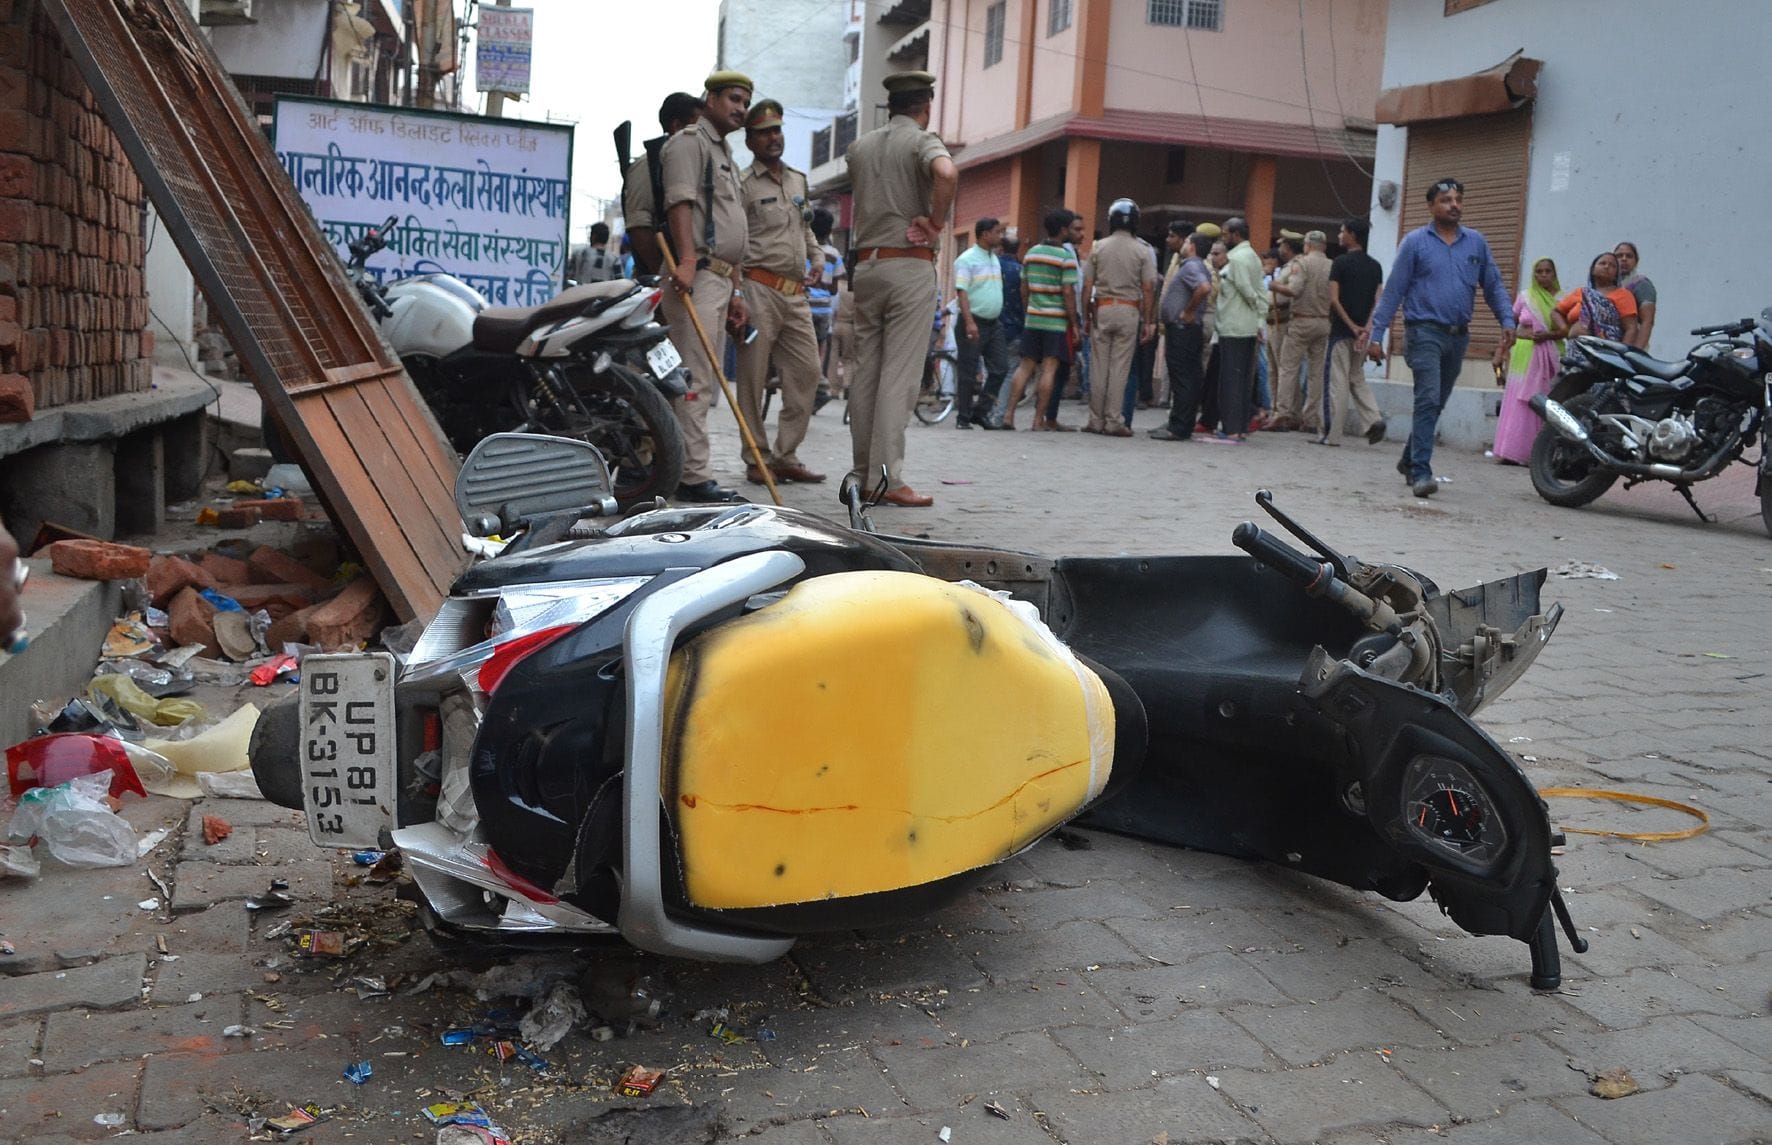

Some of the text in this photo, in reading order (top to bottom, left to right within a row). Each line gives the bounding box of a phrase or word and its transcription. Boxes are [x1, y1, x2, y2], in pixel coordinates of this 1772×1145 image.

[478, 26, 530, 40] CLASSES
[307, 109, 340, 132] आर्ट
[348, 111, 385, 136] ऑफ
[391, 114, 454, 144] डिलाइट
[366, 158, 433, 210] आनन्द
[433, 166, 475, 210] कला
[477, 158, 512, 215] सेवा
[512, 167, 570, 219] संस्थान
[386, 214, 441, 259] भक्ति
[442, 218, 481, 262] सेवा
[307, 672, 344, 834] BK-3153
[344, 701, 377, 806] UP 81
